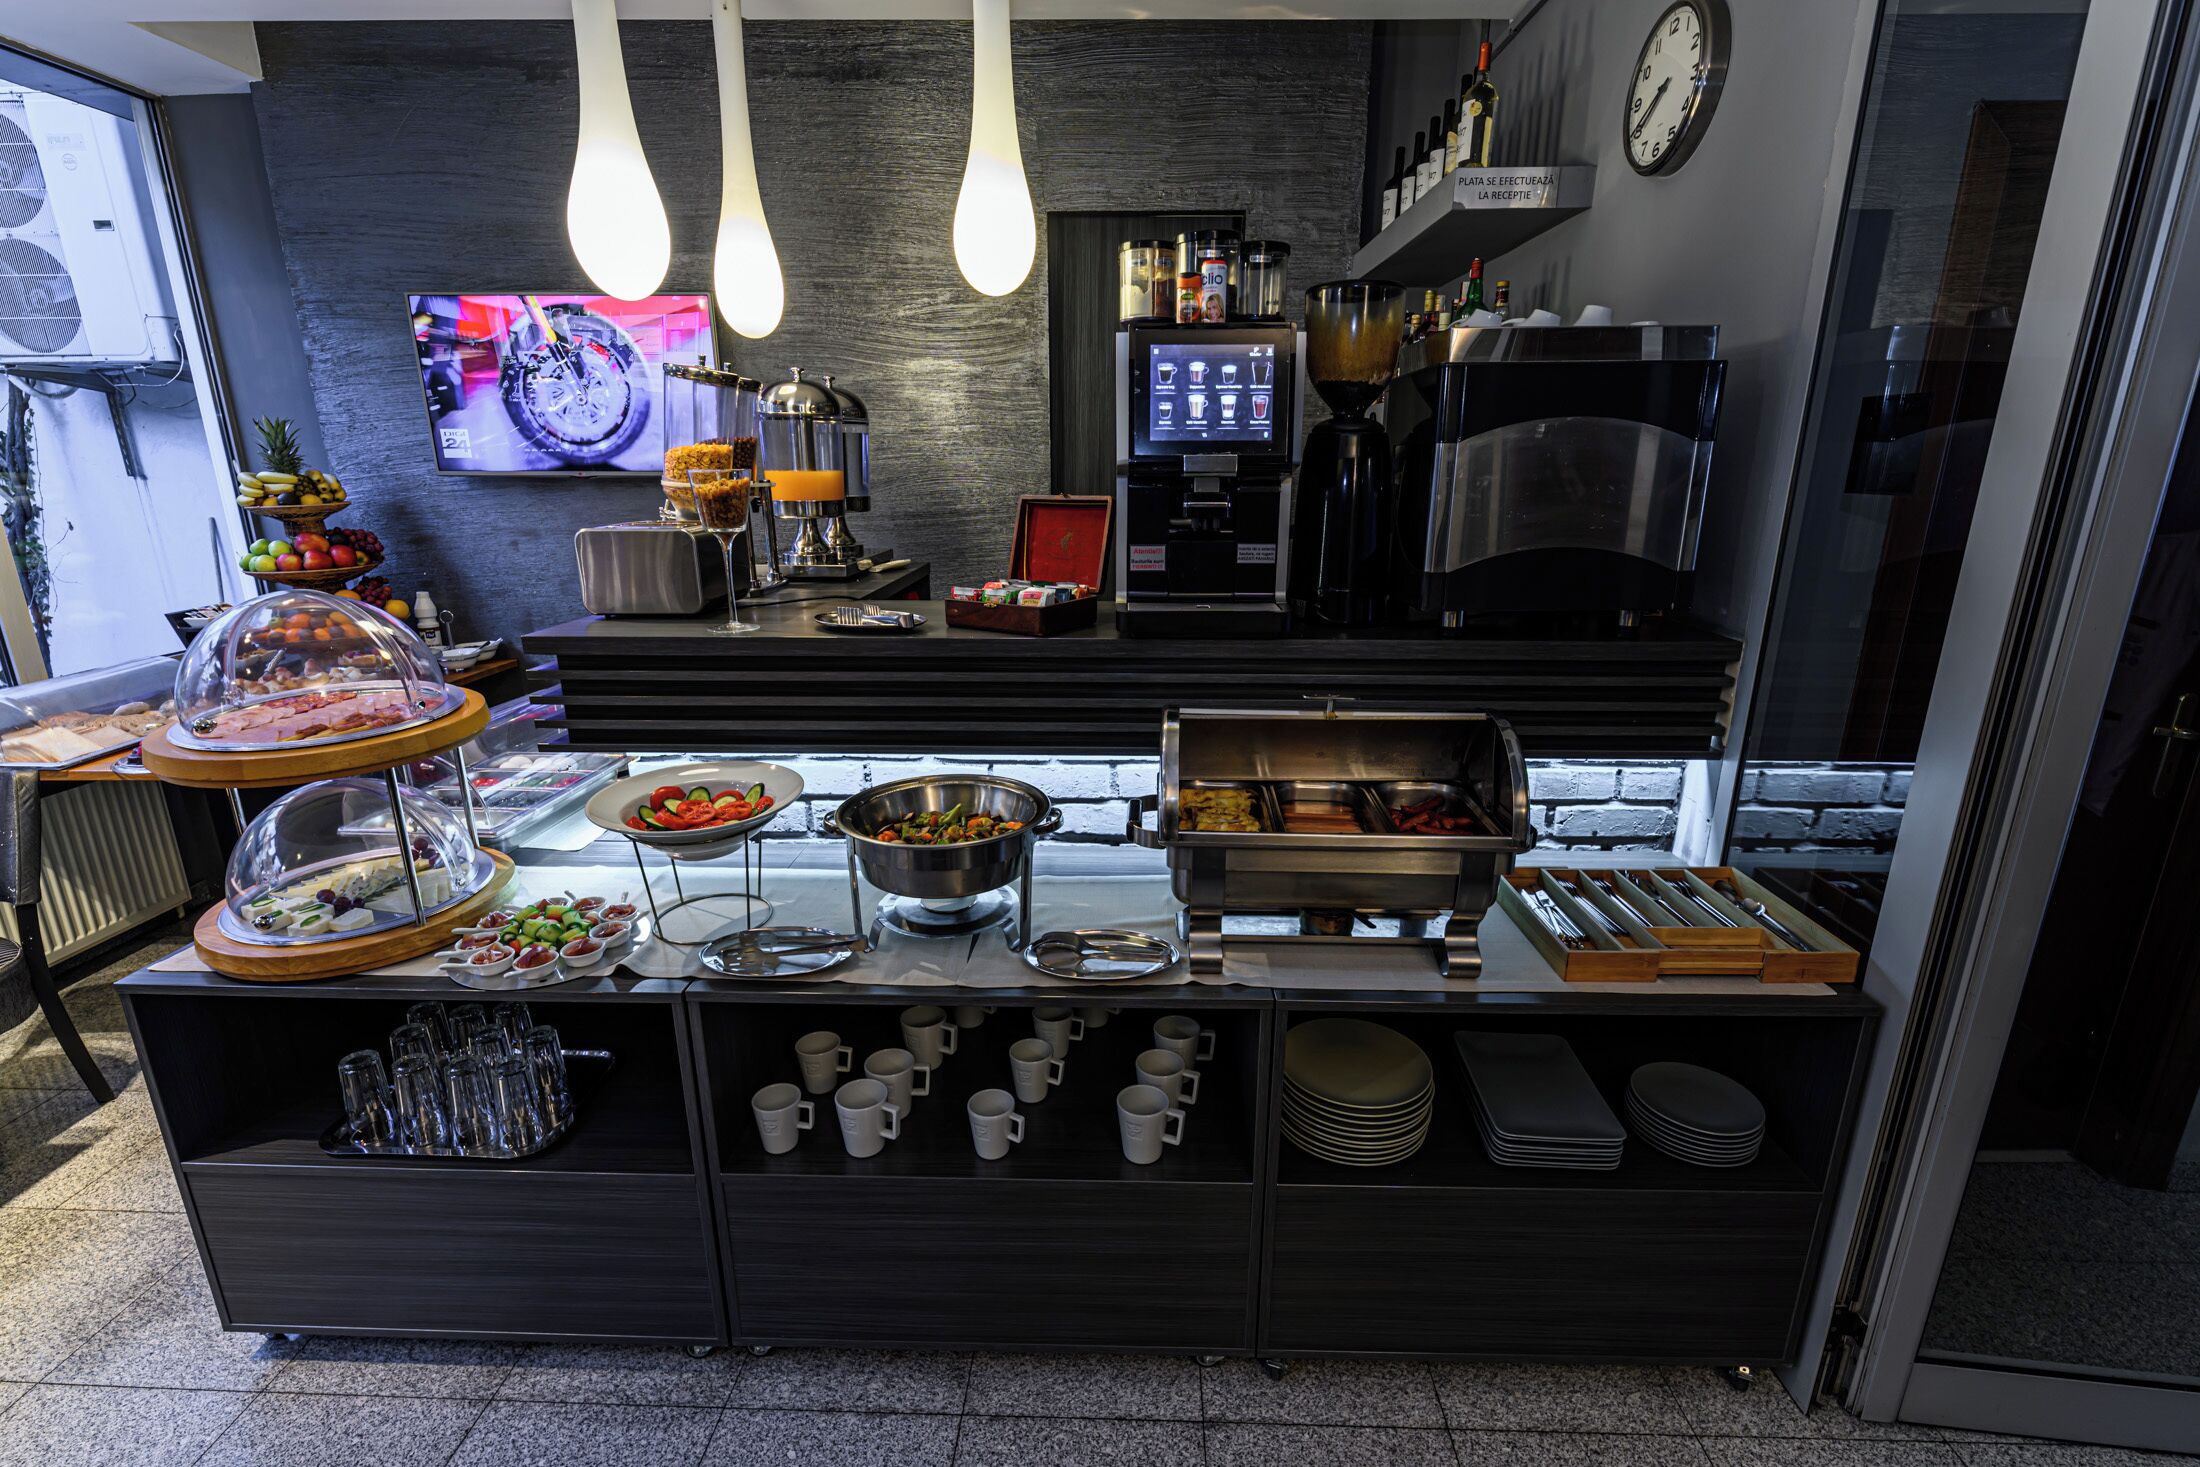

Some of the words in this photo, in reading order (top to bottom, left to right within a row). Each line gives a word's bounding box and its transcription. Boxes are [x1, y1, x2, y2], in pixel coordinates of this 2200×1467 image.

[1668, 16, 1681, 37] 12
[1686, 15, 1691, 32] 1
[1654, 38, 1663, 56] 11
[1690, 32, 1701, 51] 2
[1642, 65, 1652, 82] 10
[1689, 62, 1700, 81] 3
[1633, 97, 1643, 114] 9
[1681, 95, 1690, 112] 4
[1666, 125, 1677, 143] 5
[1641, 140, 1649, 157] 7
[1651, 142, 1660, 158] 6
[1458, 176, 1485, 186] PLATA
[1486, 176, 1498, 186] SE
[1499, 174, 1554, 186] EFECTUEAZĂ
[1478, 191, 1489, 200] LA
[1202, 272, 1223, 286] clio
[444, 438, 468, 451] 24
